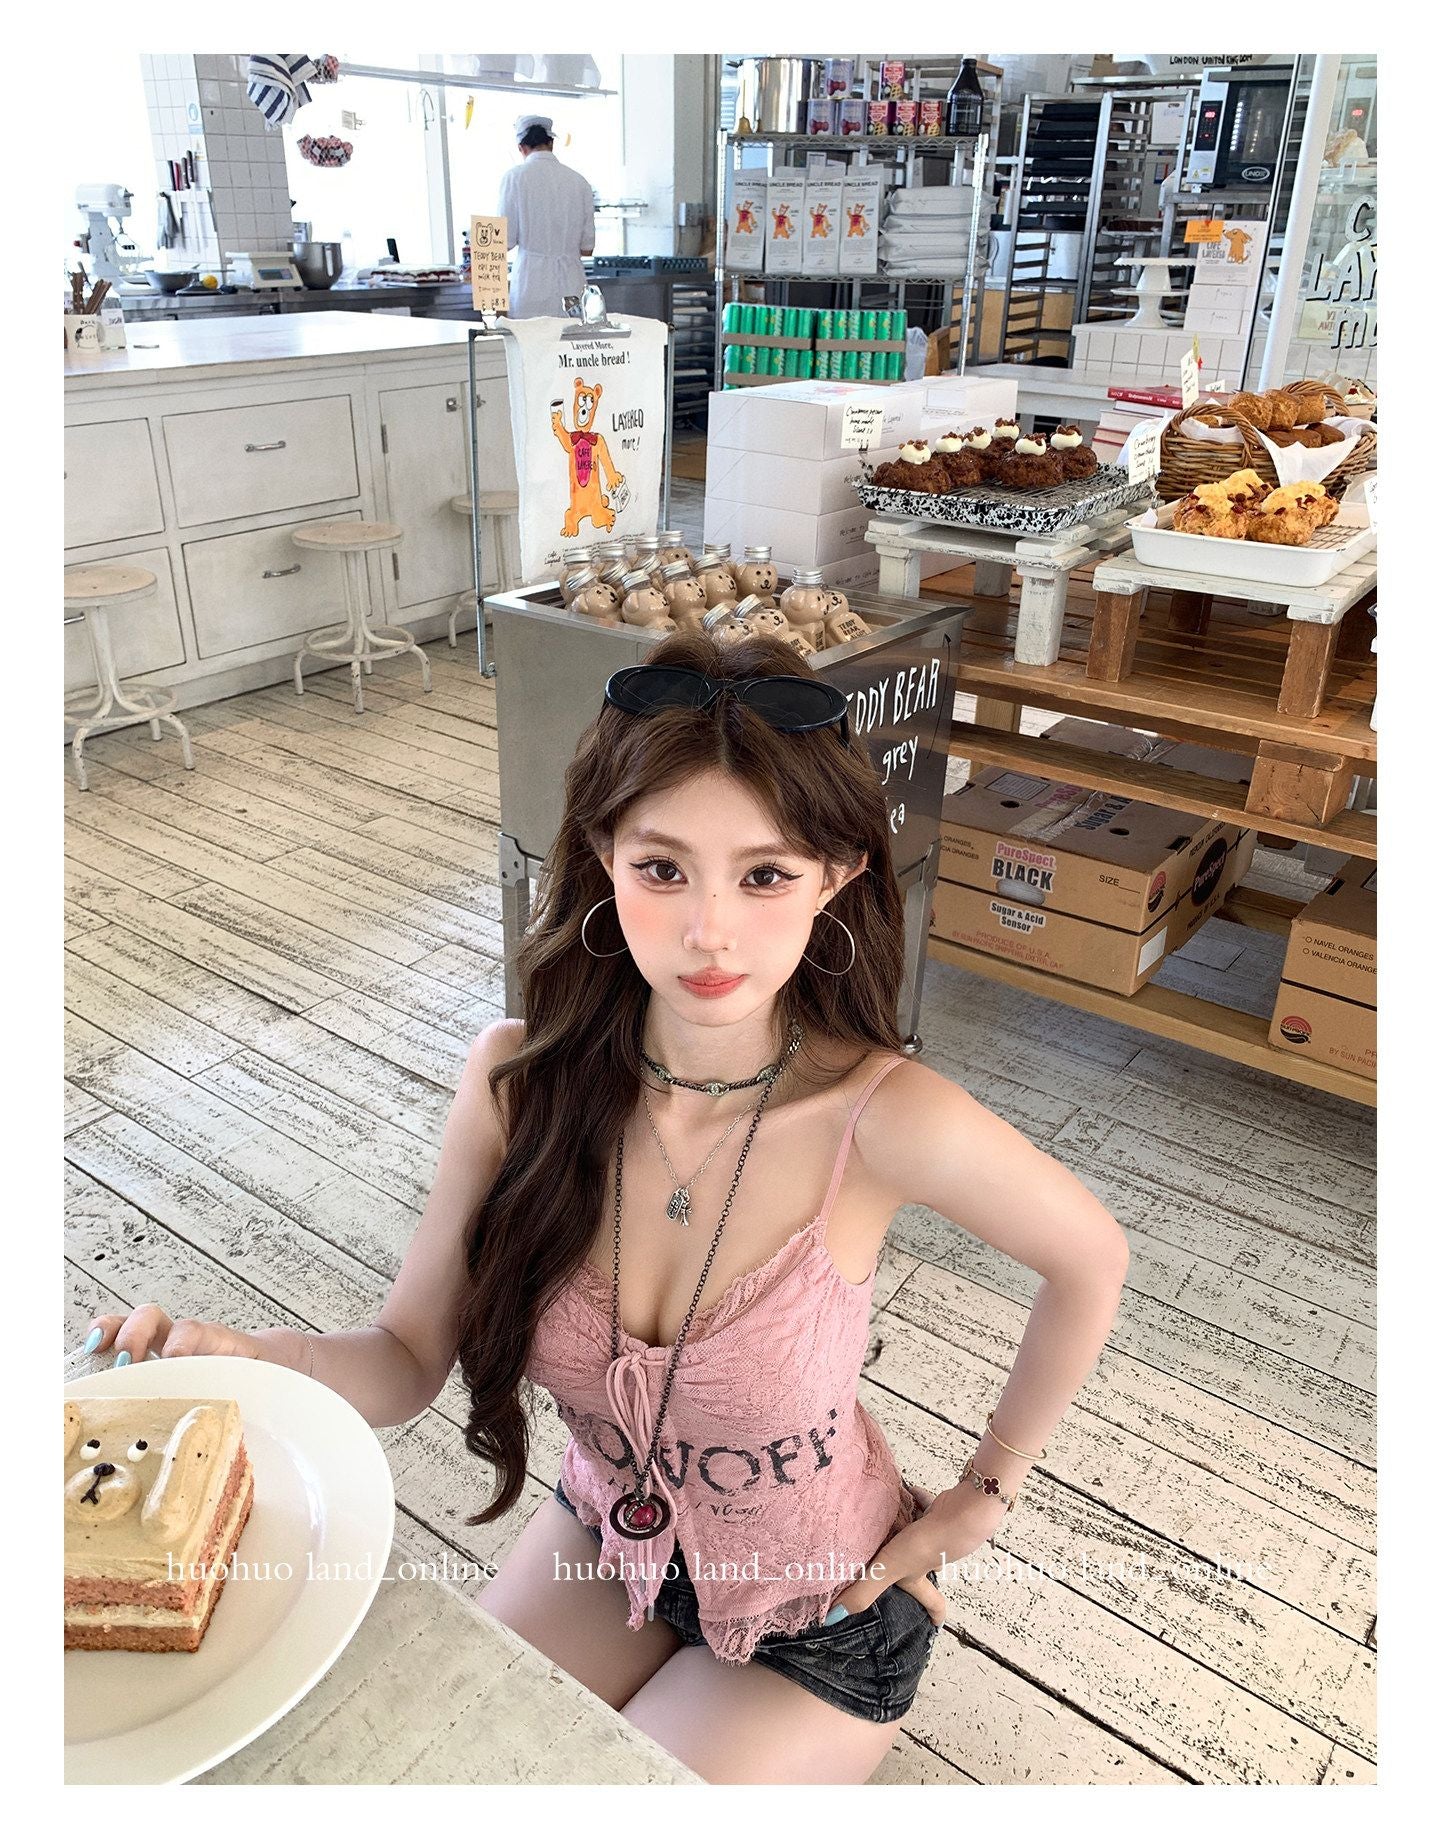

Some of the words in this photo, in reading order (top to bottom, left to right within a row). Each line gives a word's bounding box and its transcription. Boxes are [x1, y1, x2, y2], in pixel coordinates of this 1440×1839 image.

[1169, 55, 1199, 65] LONDON
[571, 341, 595, 352] Layered
[558, 354, 574, 368] Mr.
[576, 353, 599, 368] uncle
[612, 409, 644, 432] LAYERED
[837, 619, 856, 631] TEDDY
[846, 678, 889, 737] DDY
[893, 658, 940, 726] BEAR
[881, 735, 919, 786] grey
[889, 802, 905, 834] ea
[952, 848, 979, 860] ORANGES
[997, 842, 1054, 868] PureSpect
[992, 857, 1053, 891] BLACK
[1099, 874, 1120, 887] SIZE
[991, 902, 1016, 917] Sugar
[1017, 911, 1023, 919] &
[1025, 912, 1044, 925] Acid
[1001, 916, 1031, 932] Sensor
[976, 930, 1014, 948] PRODUCE
[1016, 942, 1027, 951] OF
[1314, 938, 1337, 950] NAVEL
[1338, 945, 1374, 961] ORANGES
[1311, 950, 1345, 965] VALENCIA
